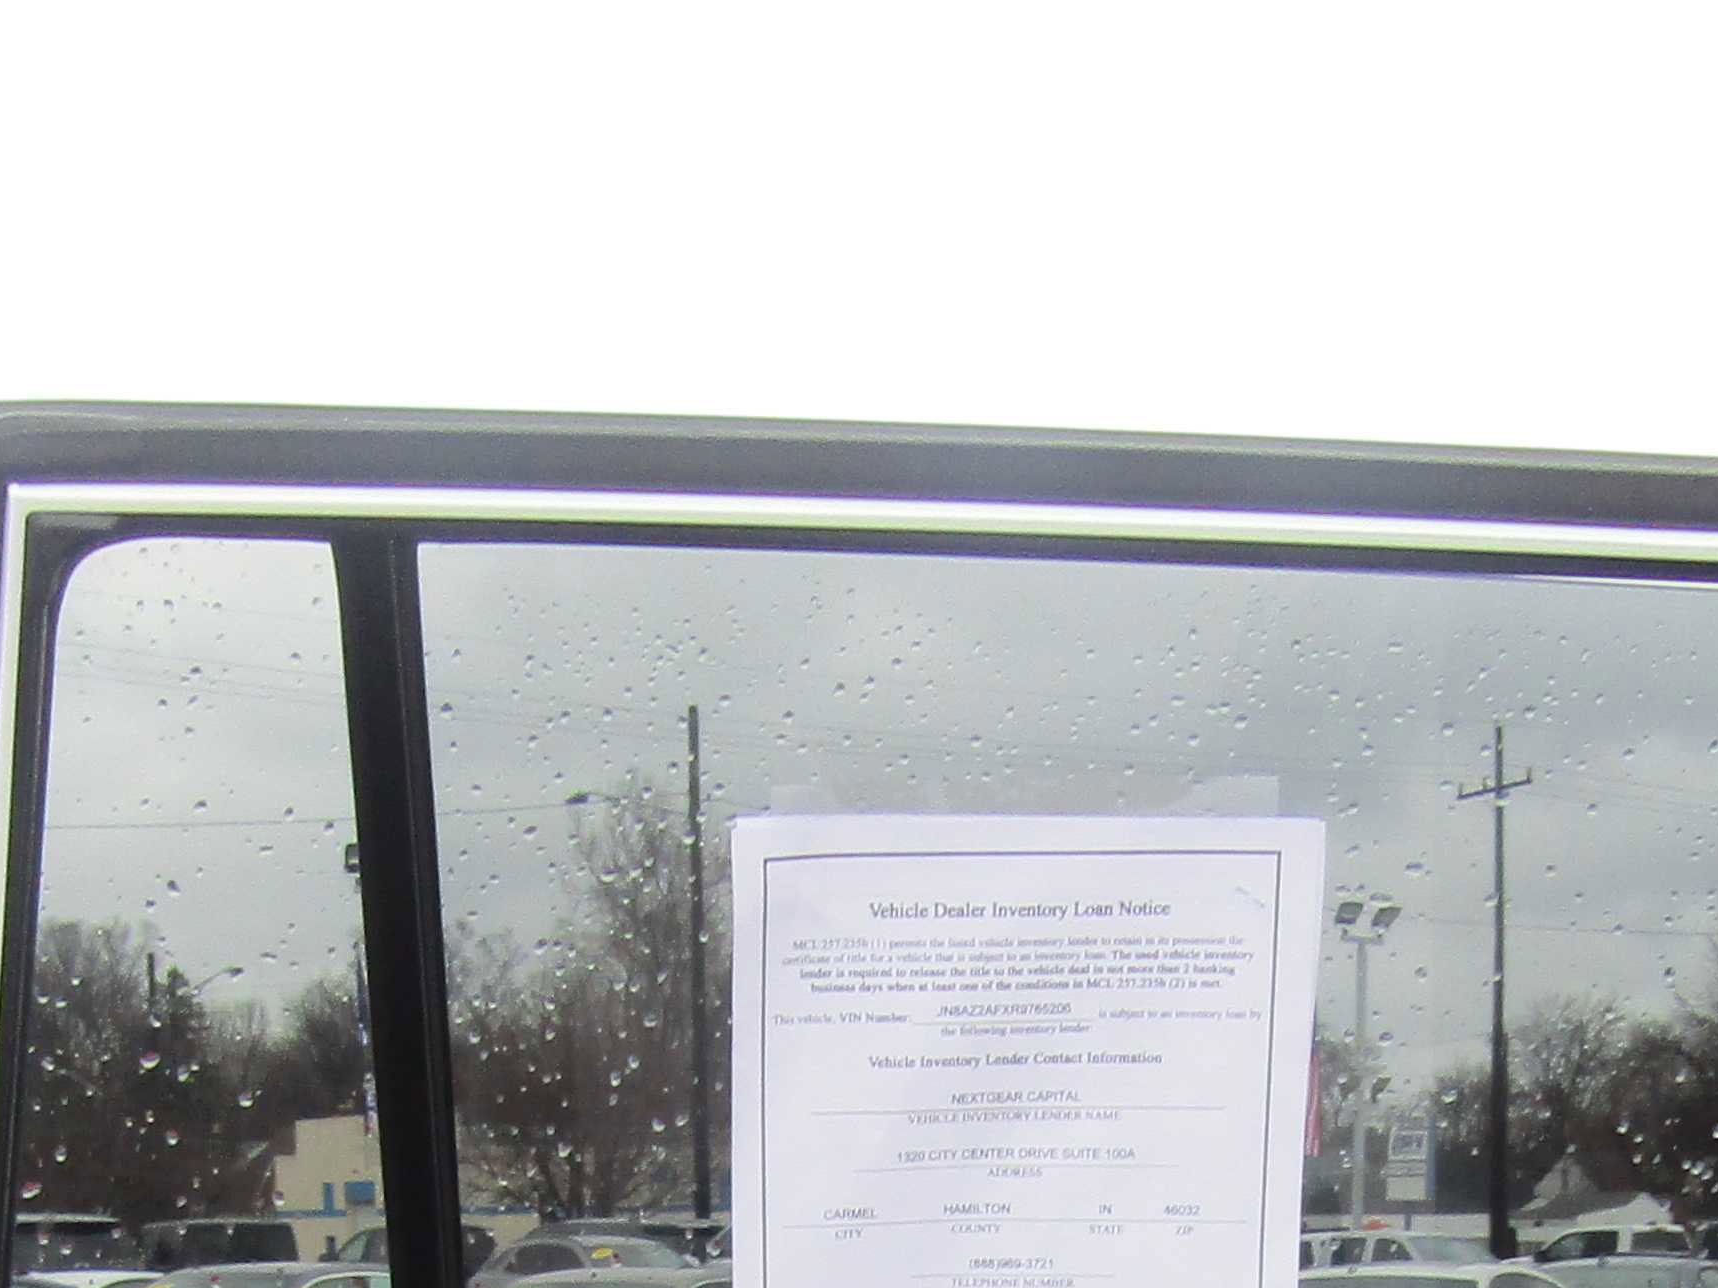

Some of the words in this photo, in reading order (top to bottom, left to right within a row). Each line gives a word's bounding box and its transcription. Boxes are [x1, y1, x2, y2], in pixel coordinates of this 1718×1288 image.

[869, 901, 928, 918] Vehicle
[934, 901, 986, 918] Dealer
[992, 900, 1068, 922] Inventory
[1075, 900, 1113, 917] Loan
[1119, 900, 1171, 917] Notice
[1017, 936, 1064, 948] inventory
[897, 952, 931, 961] vehicle
[1035, 950, 1080, 962] inventory
[1111, 950, 1131, 959] The
[1163, 949, 1200, 959] vehicle
[1204, 949, 1254, 961] inventory
[800, 968, 832, 978] lender
[848, 967, 892, 980] required
[909, 967, 946, 977] release
[950, 967, 965, 976] the
[970, 966, 990, 976] title
[1008, 966, 1023, 975] the
[1027, 965, 1064, 975] vehicle
[1193, 965, 1235, 977] banking
[811, 983, 855, 992] business
[859, 982, 883, 994] days
[887, 982, 915, 992] when
[932, 981, 955, 991] least
[996, 980, 1012, 990] the
[1015, 979, 1069, 989] conditions
[839, 1012, 862, 1023] VIN
[1176, 1009, 1222, 1021] inventory
[960, 1026, 1005, 1038] following
[1010, 1024, 1056, 1036] inventory
[869, 1056, 915, 1068] Vehicle
[921, 1056, 980, 1071] Inventory
[986, 1054, 1029, 1067] Lender
[1033, 1053, 1083, 1065] Contact
[1087, 1053, 1162, 1065] Information
[952, 1092, 1021, 1104] NEXTGEAR
[1027, 1091, 1081, 1102] CAPITAL
[907, 1113, 959, 1124] VEHICLE
[962, 1111, 1031, 1122] INVENTORY
[1085, 1110, 1121, 1121] NAME
[898, 1151, 925, 1163] 1320
[928, 1150, 958, 1161] CITY
[961, 1148, 1015, 1160] CENTER
[1018, 1148, 1058, 1160] DRIVE
[1062, 1148, 1100, 1160] SUITE
[823, 1208, 878, 1220] CARMEL
[943, 1203, 1011, 1215] HAMILTON
[1098, 1204, 1113, 1215] IN
[835, 1228, 863, 1240] CITY
[951, 1223, 1001, 1234] COUNTY
[1088, 1225, 1123, 1235] STATE
[952, 1278, 1019, 1288] TELEPHONE
[1023, 1278, 1074, 1288] NUMBER
